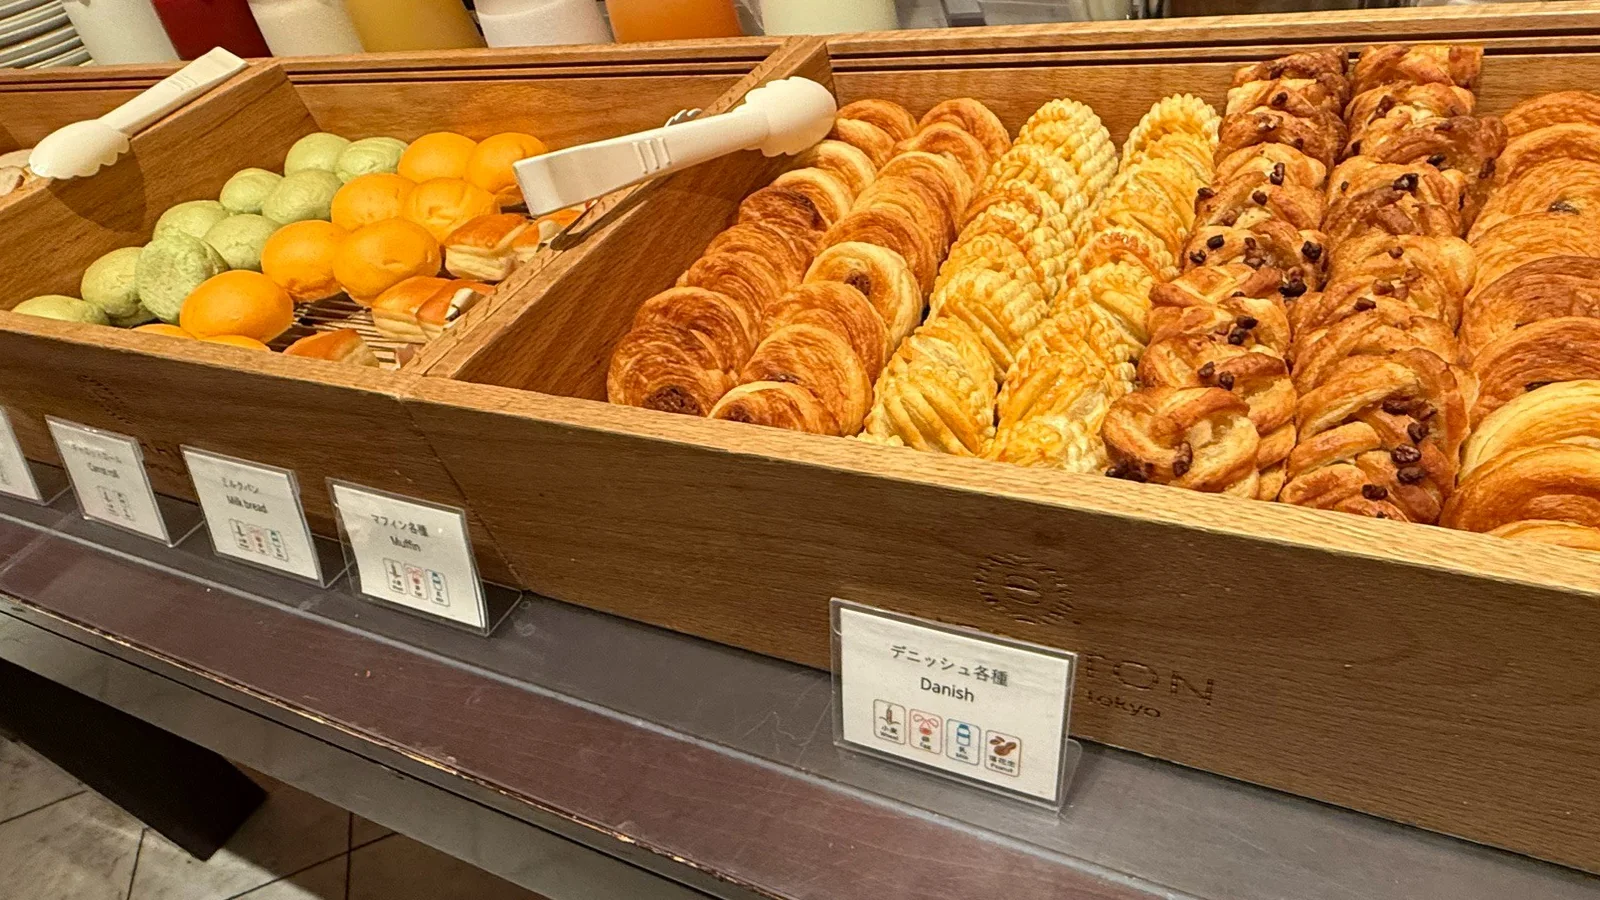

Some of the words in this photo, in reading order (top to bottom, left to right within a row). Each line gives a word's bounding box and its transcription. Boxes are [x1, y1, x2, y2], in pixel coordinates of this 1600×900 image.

[221, 476, 260, 494] ミルクパン
[226, 494, 244, 508] Milk
[242, 498, 269, 514] bread
[370, 513, 429, 537] マフィン各種
[389, 535, 422, 552] Muffin
[890, 644, 1008, 687] デニッシュ各種
[920, 676, 975, 703] Danish
